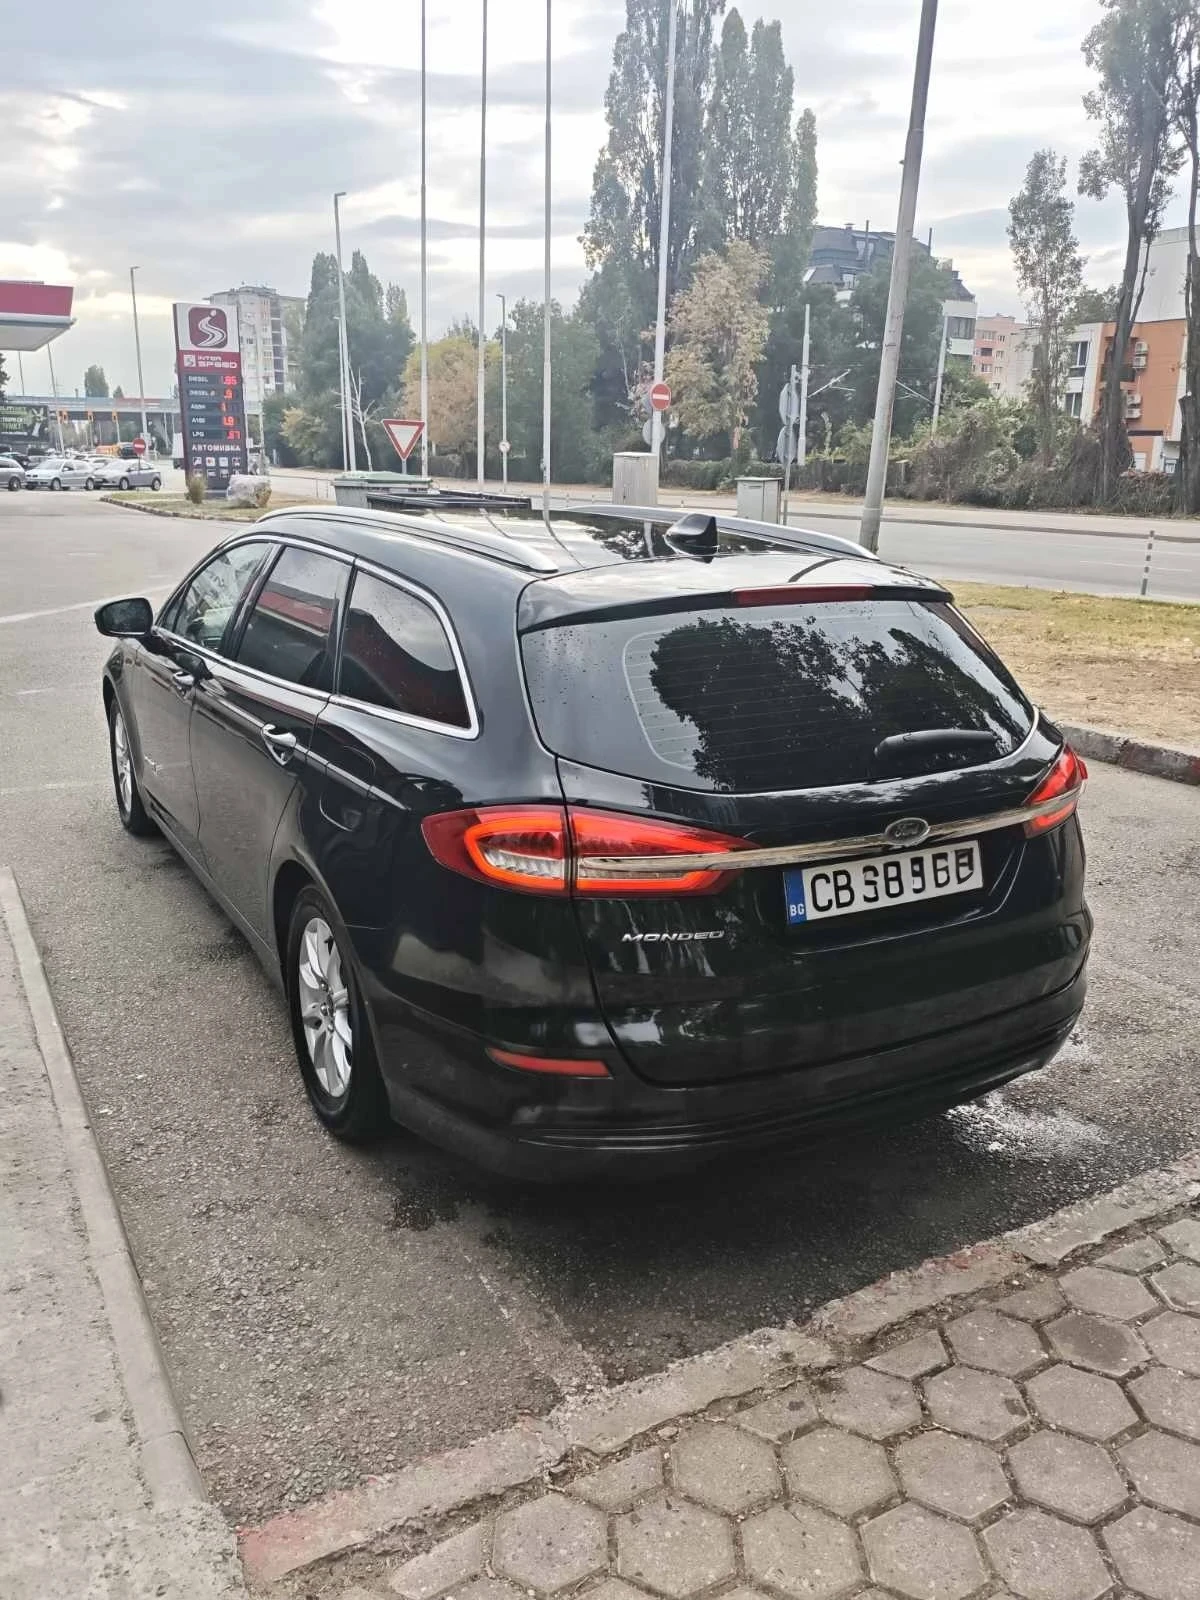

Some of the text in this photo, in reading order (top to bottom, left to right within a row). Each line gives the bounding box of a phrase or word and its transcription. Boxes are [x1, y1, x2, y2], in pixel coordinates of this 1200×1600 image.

[197, 361, 238, 369] SPEED
[191, 444, 241, 452] АВТОМИВКА
[789, 903, 805, 916] BG
[621, 930, 725, 942] MONDEO
